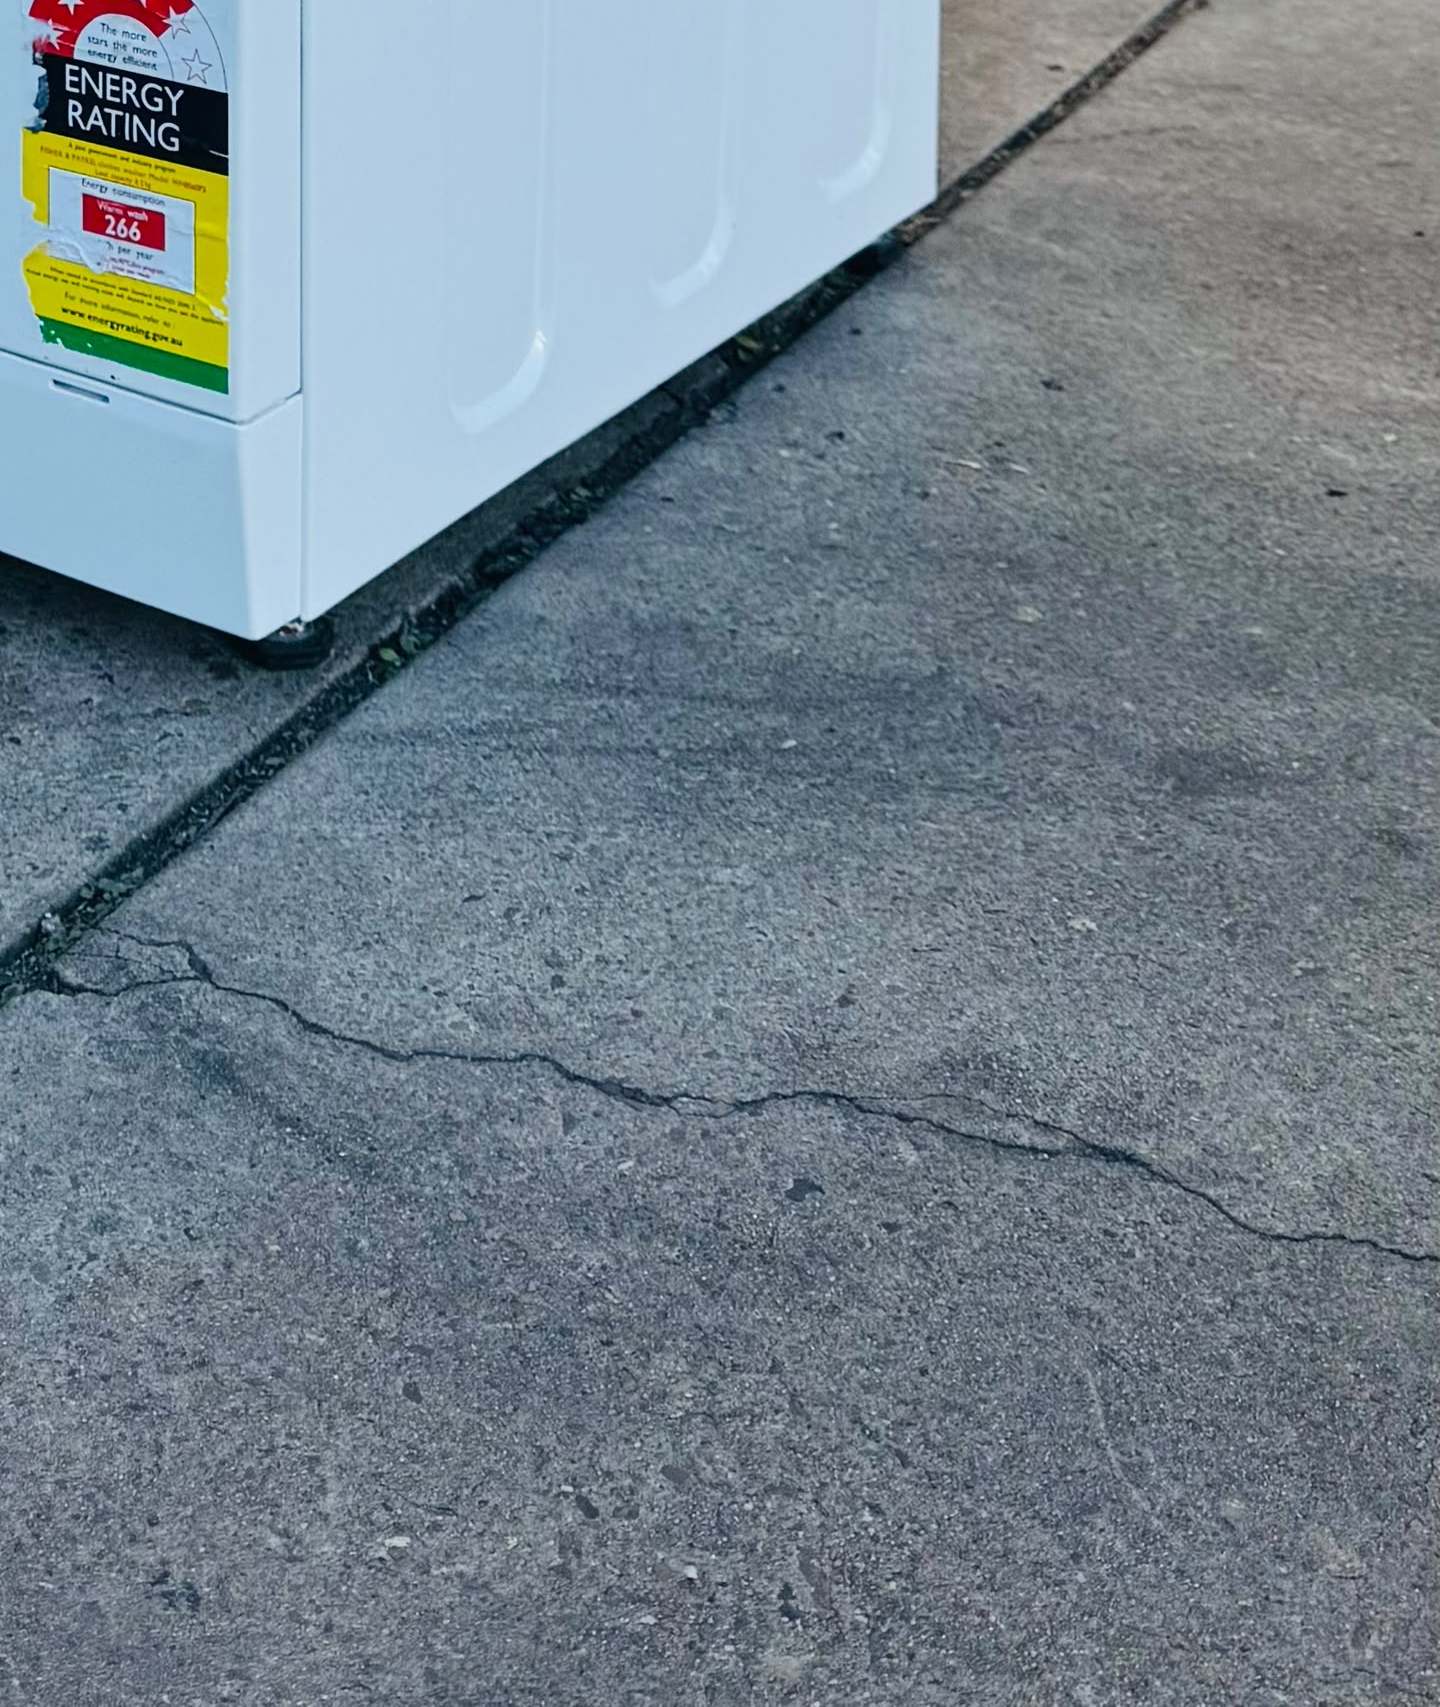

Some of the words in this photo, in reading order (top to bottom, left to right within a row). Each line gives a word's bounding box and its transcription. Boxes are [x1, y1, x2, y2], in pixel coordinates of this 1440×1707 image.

[100, 22, 117, 36] The
[121, 30, 147, 42] more
[87, 36, 108, 48] stars
[113, 41, 128, 51] the
[132, 47, 158, 59] more
[87, 49, 117, 64] energy
[122, 56, 158, 71] efficient
[65, 63, 185, 116] ENERGY
[67, 99, 180, 152] RATING
[81, 178, 108, 194] Energy
[112, 187, 166, 207] consumption
[96, 199, 123, 216] Warm
[104, 214, 141, 242] 266
